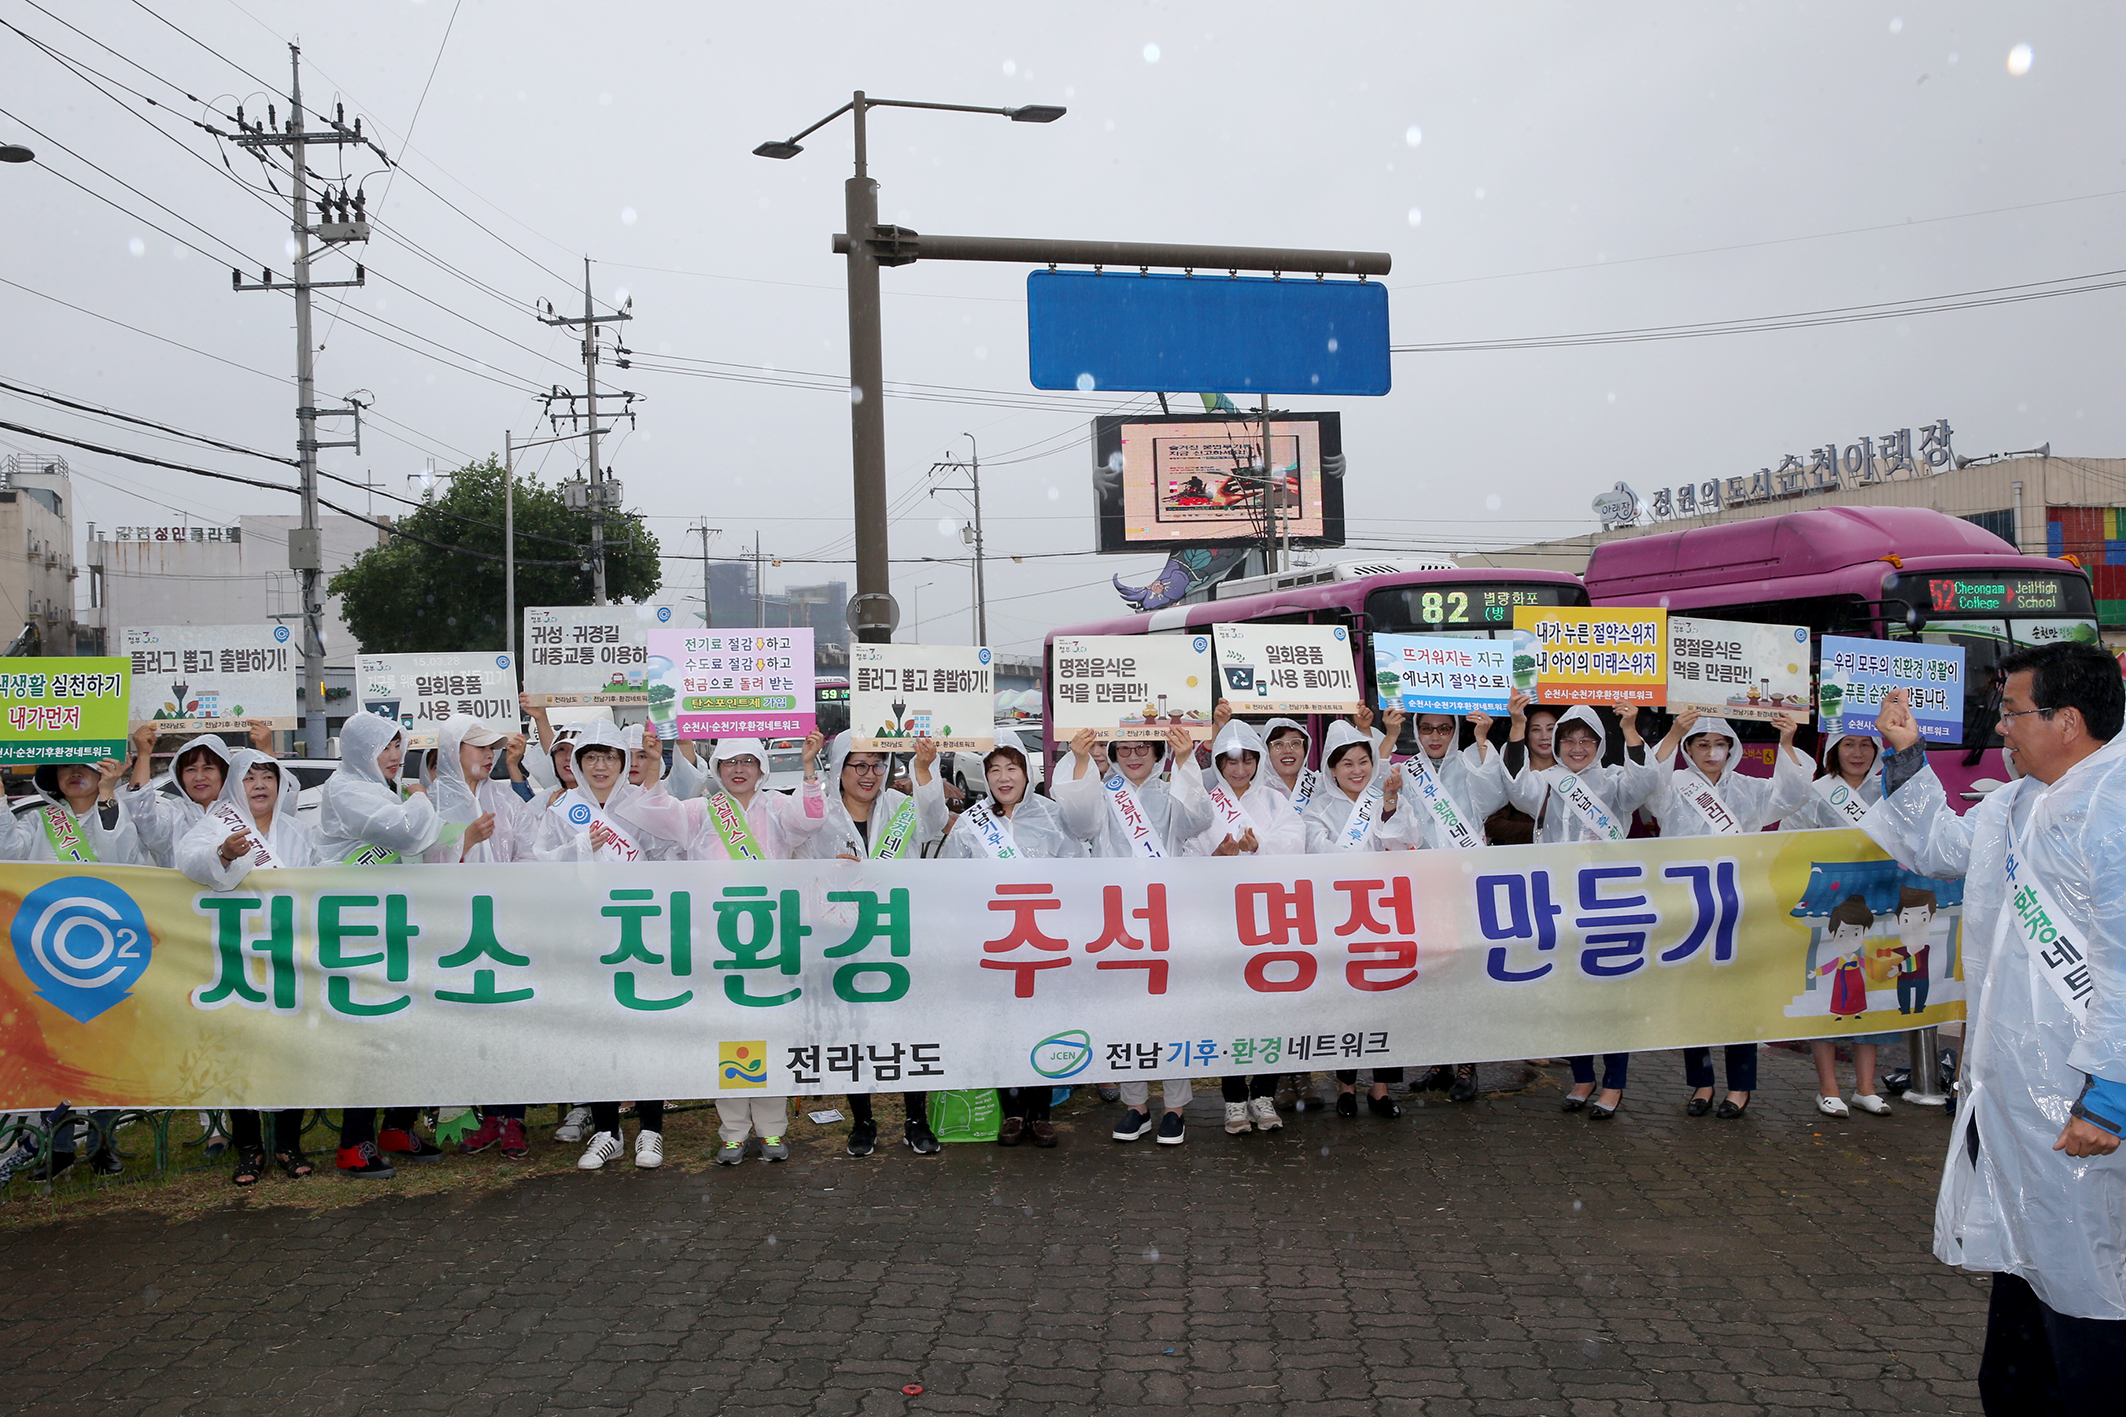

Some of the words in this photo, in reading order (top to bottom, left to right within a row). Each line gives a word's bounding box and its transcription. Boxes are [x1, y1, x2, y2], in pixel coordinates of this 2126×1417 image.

[1929, 580, 1956, 610] 52
[1954, 581, 2005, 595] Cheongam
[1422, 592, 1469, 623] 82
[1483, 591, 1539, 606] 별량화포
[1959, 596, 1999, 609] College
[2018, 596, 2056, 608] School
[1535, 622, 1561, 643] 내가
[1565, 624, 1589, 643] 누른
[1593, 623, 1655, 644] 절약스위치
[2032, 625, 2058, 639] 순천만
[684, 637, 722, 651] 전기료
[728, 637, 753, 651] 절감
[766, 637, 792, 650] 하고
[1673, 637, 1742, 660] 명절음식은
[131, 650, 177, 674] 플러그
[183, 650, 214, 673] 뽑고
[220, 648, 287, 673] 출발하기!
[532, 646, 595, 665] 대중교통
[601, 646, 648, 664] 이용하
[685, 658, 723, 672] 수도료
[728, 657, 753, 671] 절감
[766, 657, 792, 670] 하고
[1266, 645, 1323, 665] 일회용품
[1403, 648, 1472, 667] 뜨거워지는
[1477, 652, 1505, 667] 지구
[1536, 652, 1548, 672] 내
[1552, 652, 1589, 673] 아이의
[1593, 653, 1655, 674] 미래스위치
[1059, 658, 1136, 678] 명절음식은
[1673, 661, 1700, 680] 먹을
[1706, 664, 1752, 684] 만큼만!
[1834, 652, 1854, 673] 우리
[1858, 655, 1889, 677] 모두의
[1892, 657, 1924, 679] 친환경
[1927, 661, 1958, 682] 생활이
[51, 673, 121, 698] 실천하기
[416, 675, 482, 696] 일회용품
[684, 677, 734, 692] 현금으로
[740, 677, 764, 691] 돌려
[769, 677, 794, 691] 받는
[858, 668, 897, 691] 플러그
[902, 668, 928, 692] 뽑고
[933, 669, 988, 693] 출발하기!
[1270, 669, 1298, 688] 사용
[1303, 669, 1352, 688] 줄이기!
[1402, 671, 1444, 688] 에너지
[1449, 673, 1511, 691] 절약으로!
[691, 698, 761, 709] 탄소포인트제
[763, 697, 786, 707] 가입
[821, 690, 838, 699] 59
[1059, 683, 1090, 703] 먹을
[1096, 683, 1148, 702] 만큼만!
[1846, 683, 1866, 703] 푸른
[9, 705, 80, 730] 내가먼저
[418, 700, 450, 721] 사용
[457, 699, 512, 718] 줄이기!
[711, 792, 746, 844] 온실가스
[1115, 790, 1149, 839] 온실가스
[1695, 791, 1734, 832] 플러그
[199, 893, 535, 1016] 저탄소
[600, 886, 911, 1011] 친환경
[979, 882, 1170, 998] 추석
[1234, 876, 1418, 992] 명절
[1476, 862, 1739, 982] 만들기
[786, 1042, 944, 1084] 전라남도
[1050, 1052, 1076, 1061] JCEN
